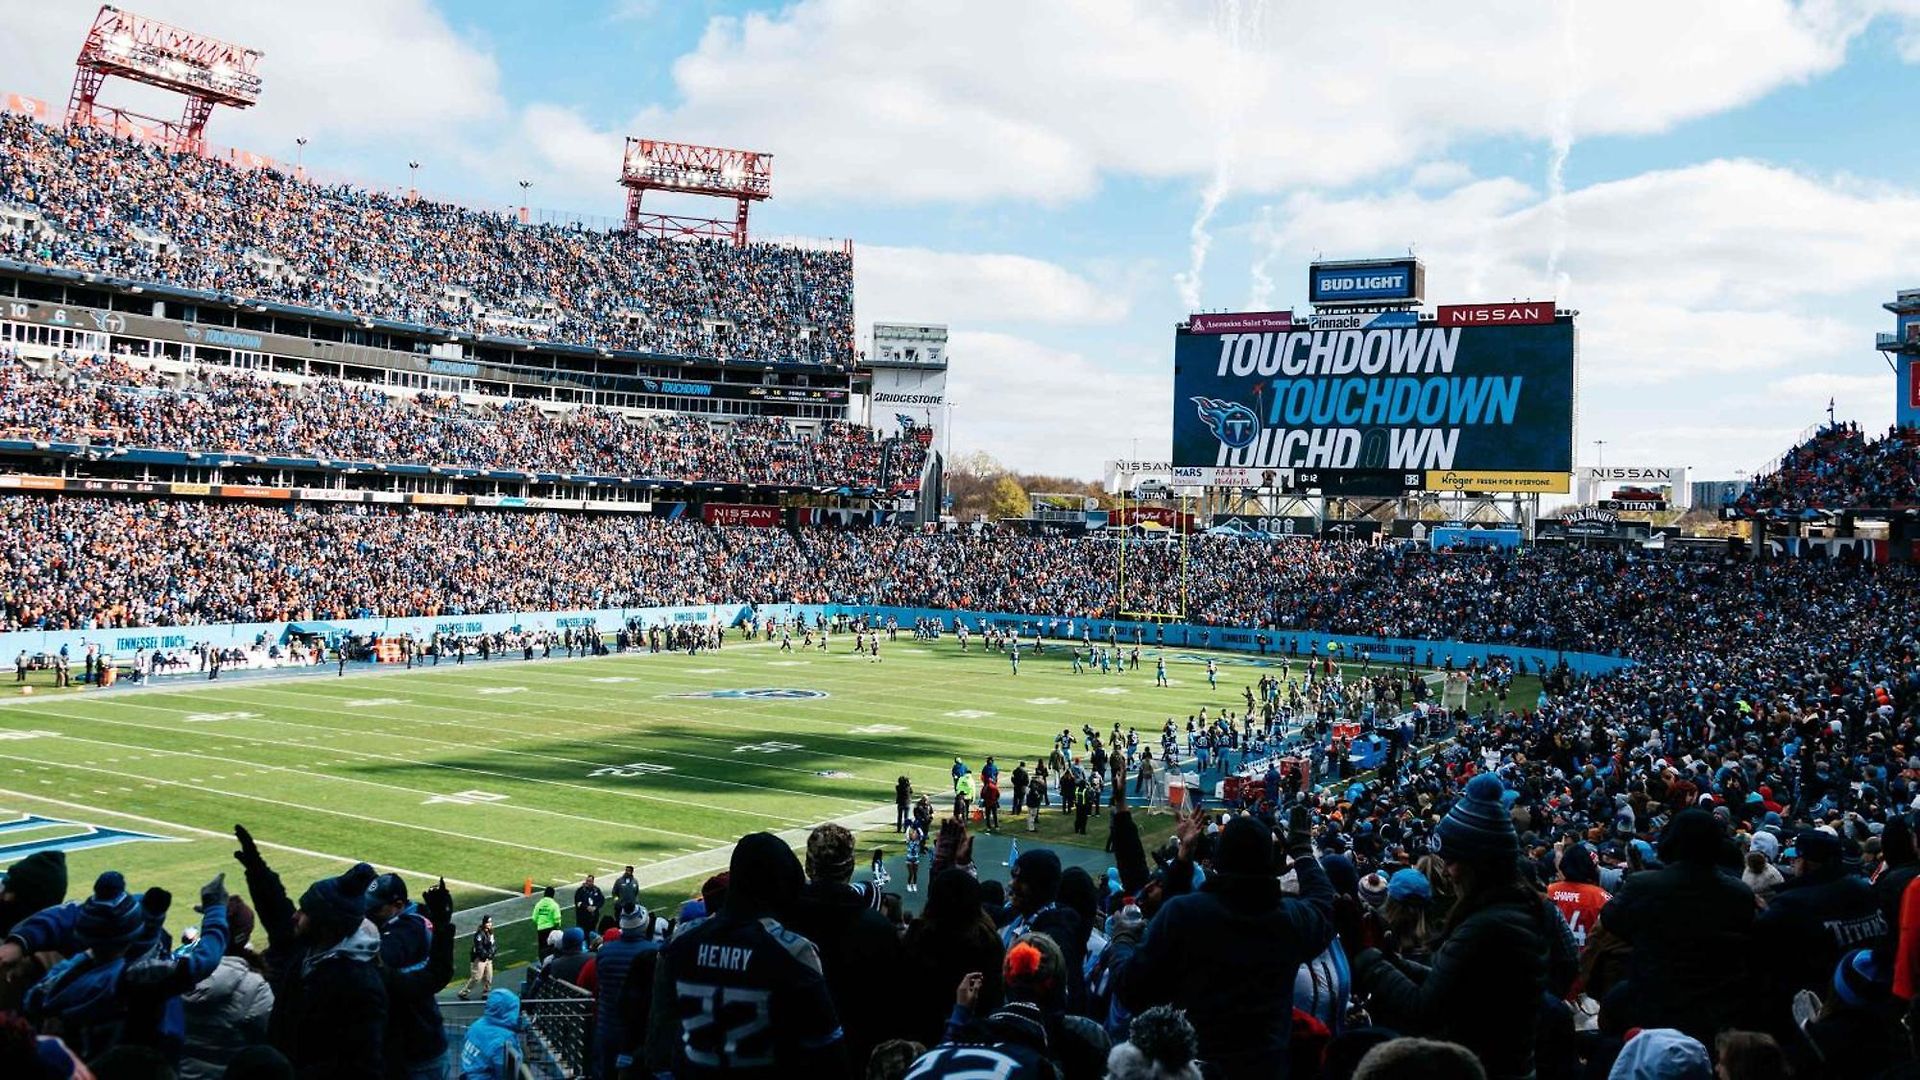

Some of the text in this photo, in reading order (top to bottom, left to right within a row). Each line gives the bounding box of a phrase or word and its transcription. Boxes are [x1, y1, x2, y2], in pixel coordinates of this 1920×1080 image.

[1320, 275, 1404, 292] BUD LIGHT
[10, 302, 28, 317] 10
[54, 309, 66, 323] 6
[1453, 308, 1539, 322] NISSAN
[1216, 328, 1461, 376] TOUCHDOWN
[661, 382, 712, 396] TOUCHDOWN
[874, 392, 943, 405] BRIDGESTONE
[1269, 376, 1522, 424] TOUCHDOWN
[1115, 462, 1173, 471] NISSAN
[1174, 467, 1203, 477] MARS
[1592, 468, 1669, 478] NISSAN
[1441, 472, 1473, 489] Kroger
[1141, 491, 1167, 500] TITAN
[714, 508, 772, 519] NISSAN
[1622, 502, 1657, 511] TITAN
[117, 636, 158, 650] TENNESSEE
[697, 943, 753, 971] HENRY
[675, 980, 776, 1069] 22
